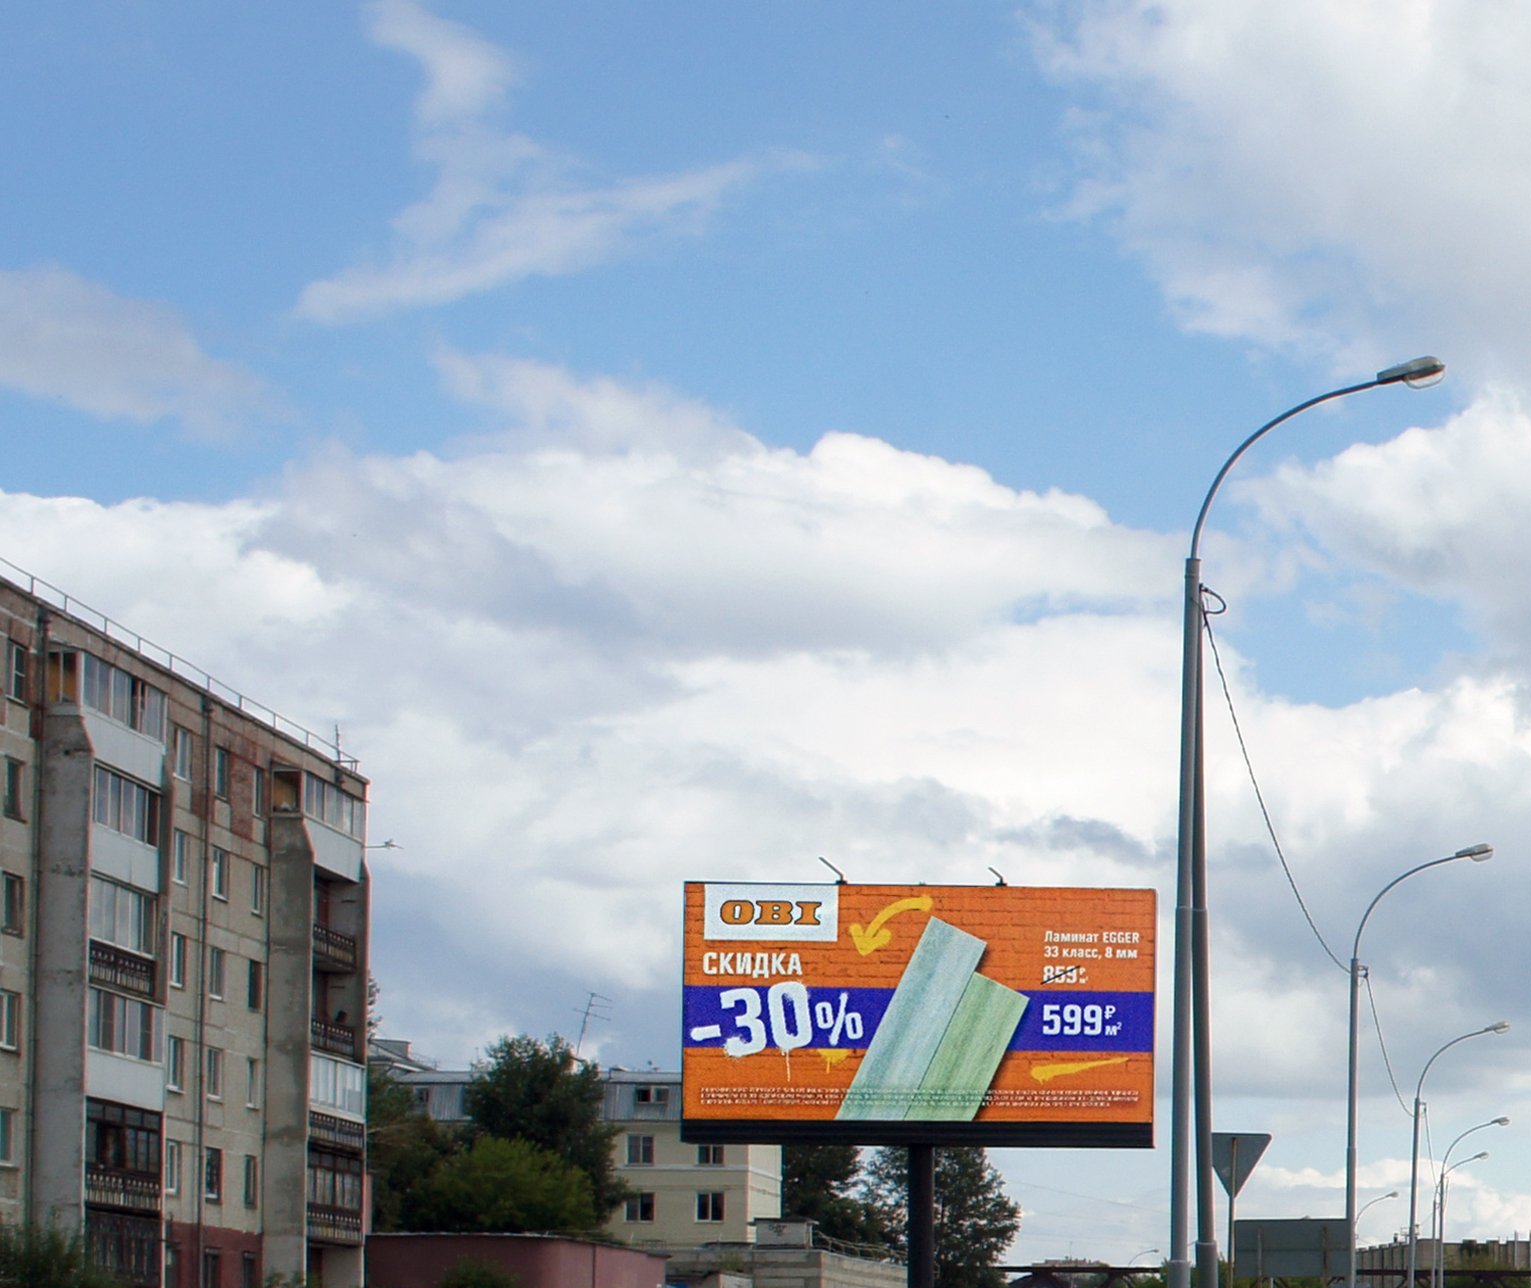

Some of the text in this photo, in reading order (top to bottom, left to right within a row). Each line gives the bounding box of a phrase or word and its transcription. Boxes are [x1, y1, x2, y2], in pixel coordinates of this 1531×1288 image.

[720, 900, 822, 925] OBI
[1044, 930, 1140, 944] Ламинат EGGER
[703, 952, 802, 978] СКИДКА
[1044, 946, 1138, 960] 33 класс, 8 мм
[690, 981, 863, 1059] -30%
[1042, 1004, 1103, 1035] 599
